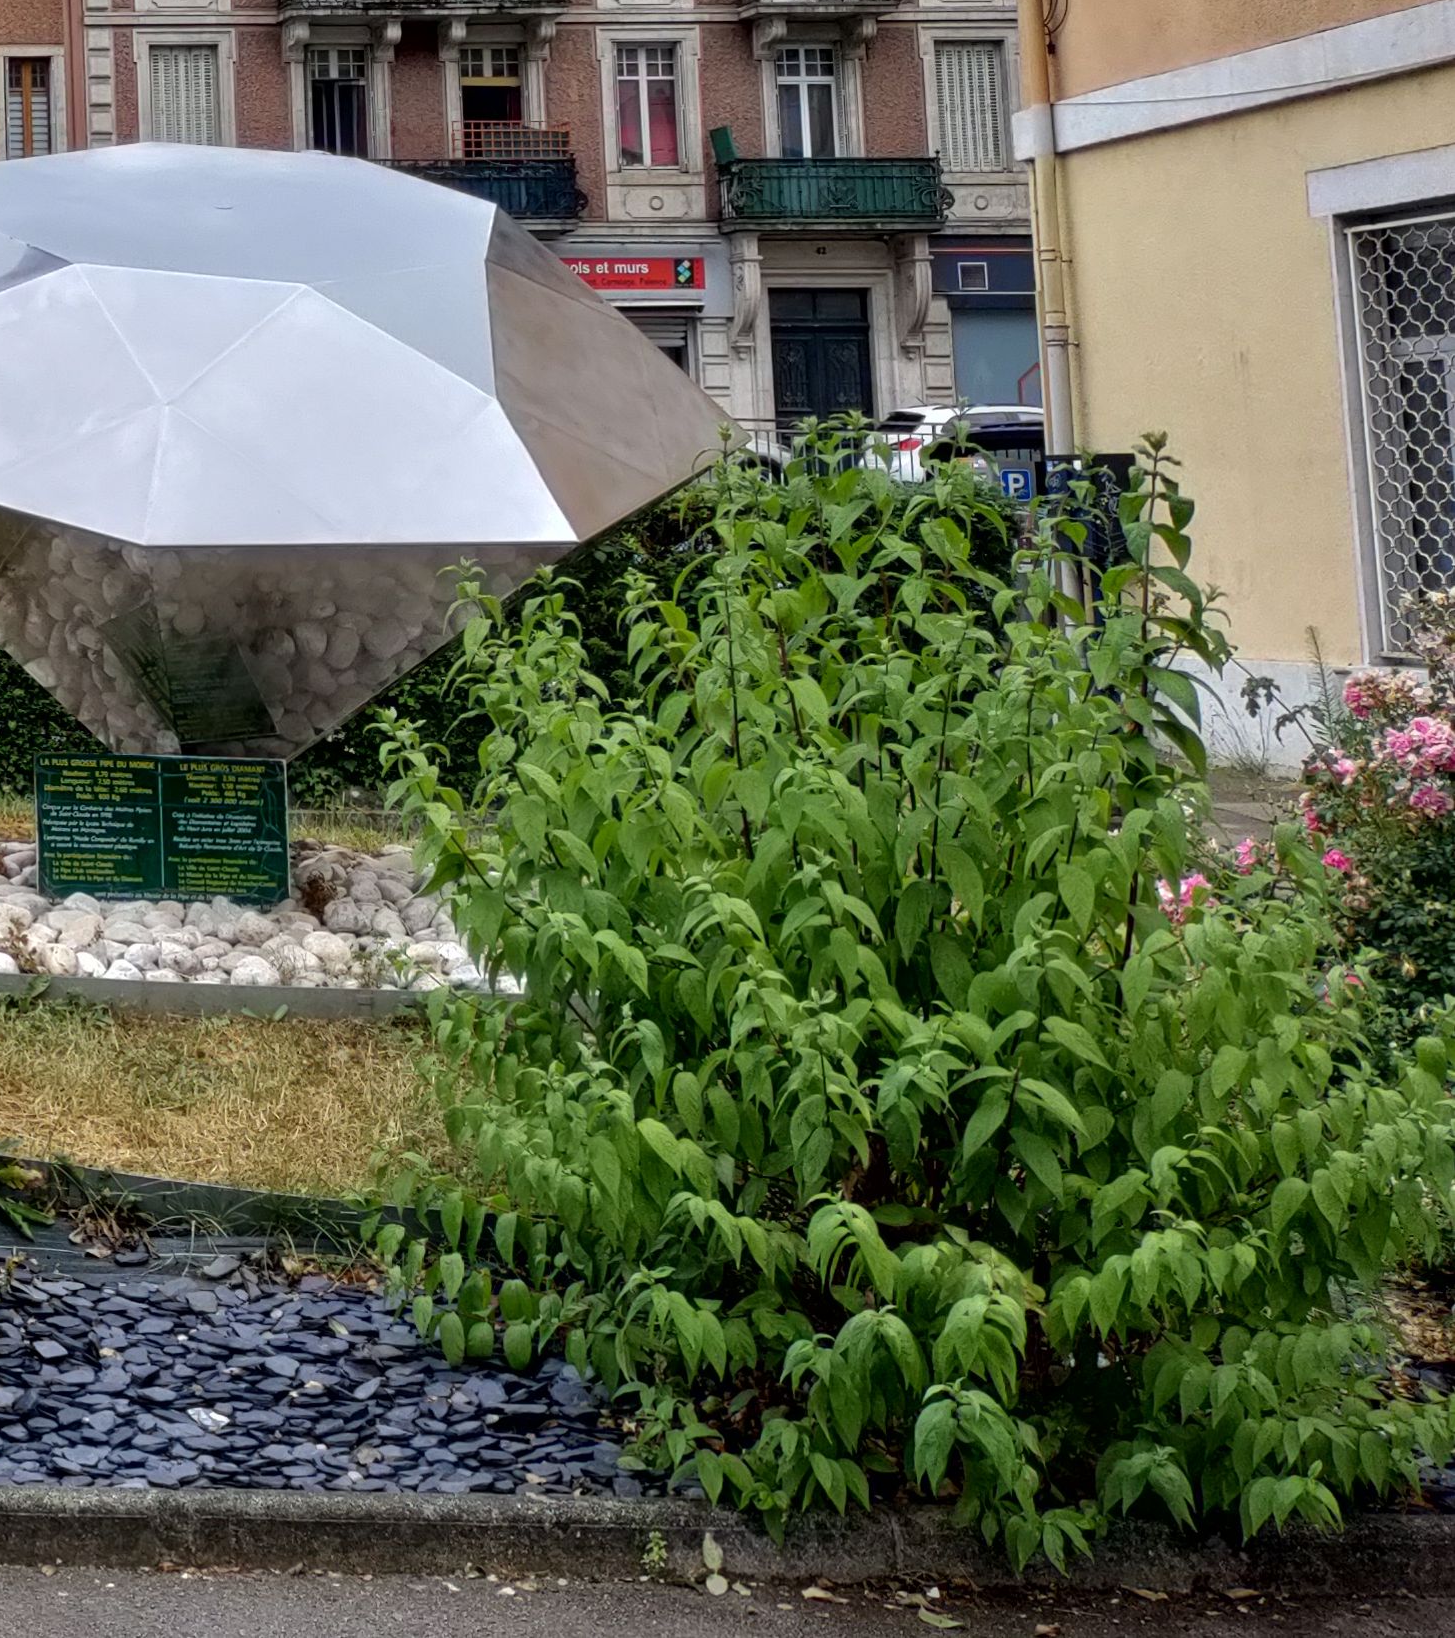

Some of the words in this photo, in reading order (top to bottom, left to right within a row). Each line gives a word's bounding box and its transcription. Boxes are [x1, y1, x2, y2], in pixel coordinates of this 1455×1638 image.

[595, 261, 609, 274] et
[614, 263, 649, 274] murs
[1008, 473, 1025, 497] P
